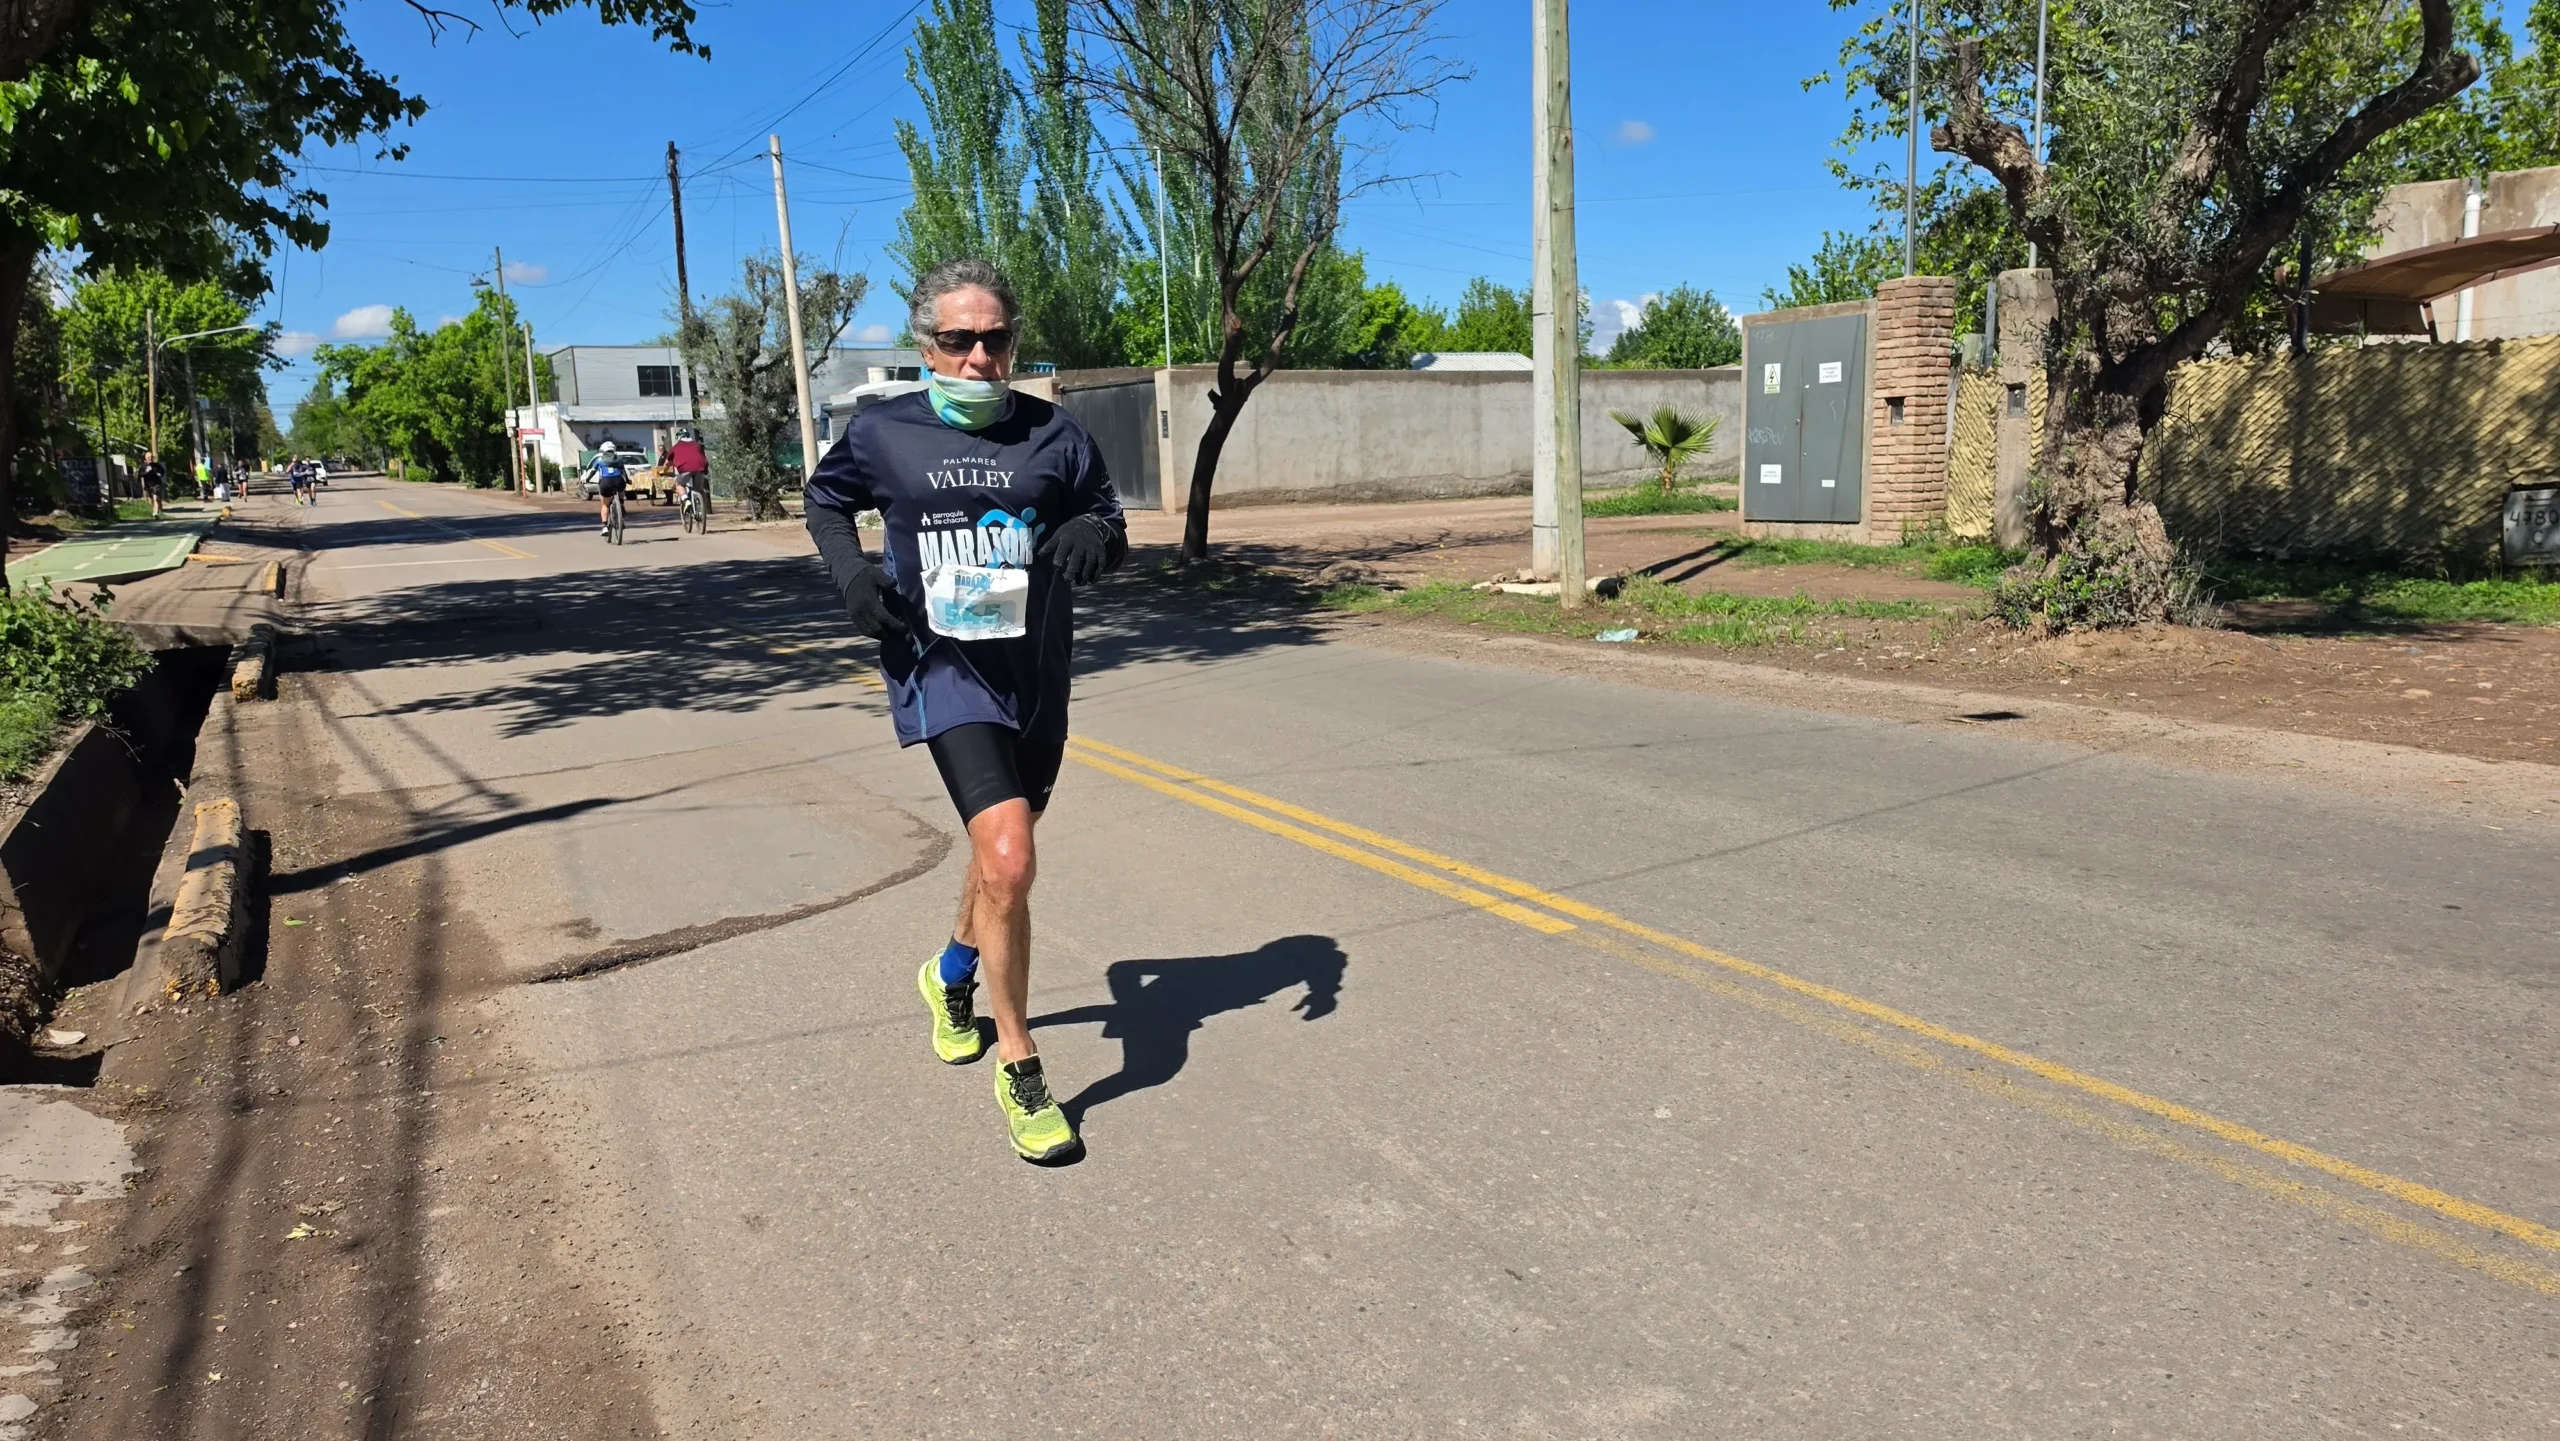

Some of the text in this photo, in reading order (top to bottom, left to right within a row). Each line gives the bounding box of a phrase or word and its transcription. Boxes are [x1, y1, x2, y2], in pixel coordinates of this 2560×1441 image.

[943, 456, 997, 466] PALMARES
[926, 468, 1014, 489] VALLEY
[932, 510, 964, 519] parroquia
[2511, 510, 2558, 526] 4780
[943, 516, 968, 524] chacras
